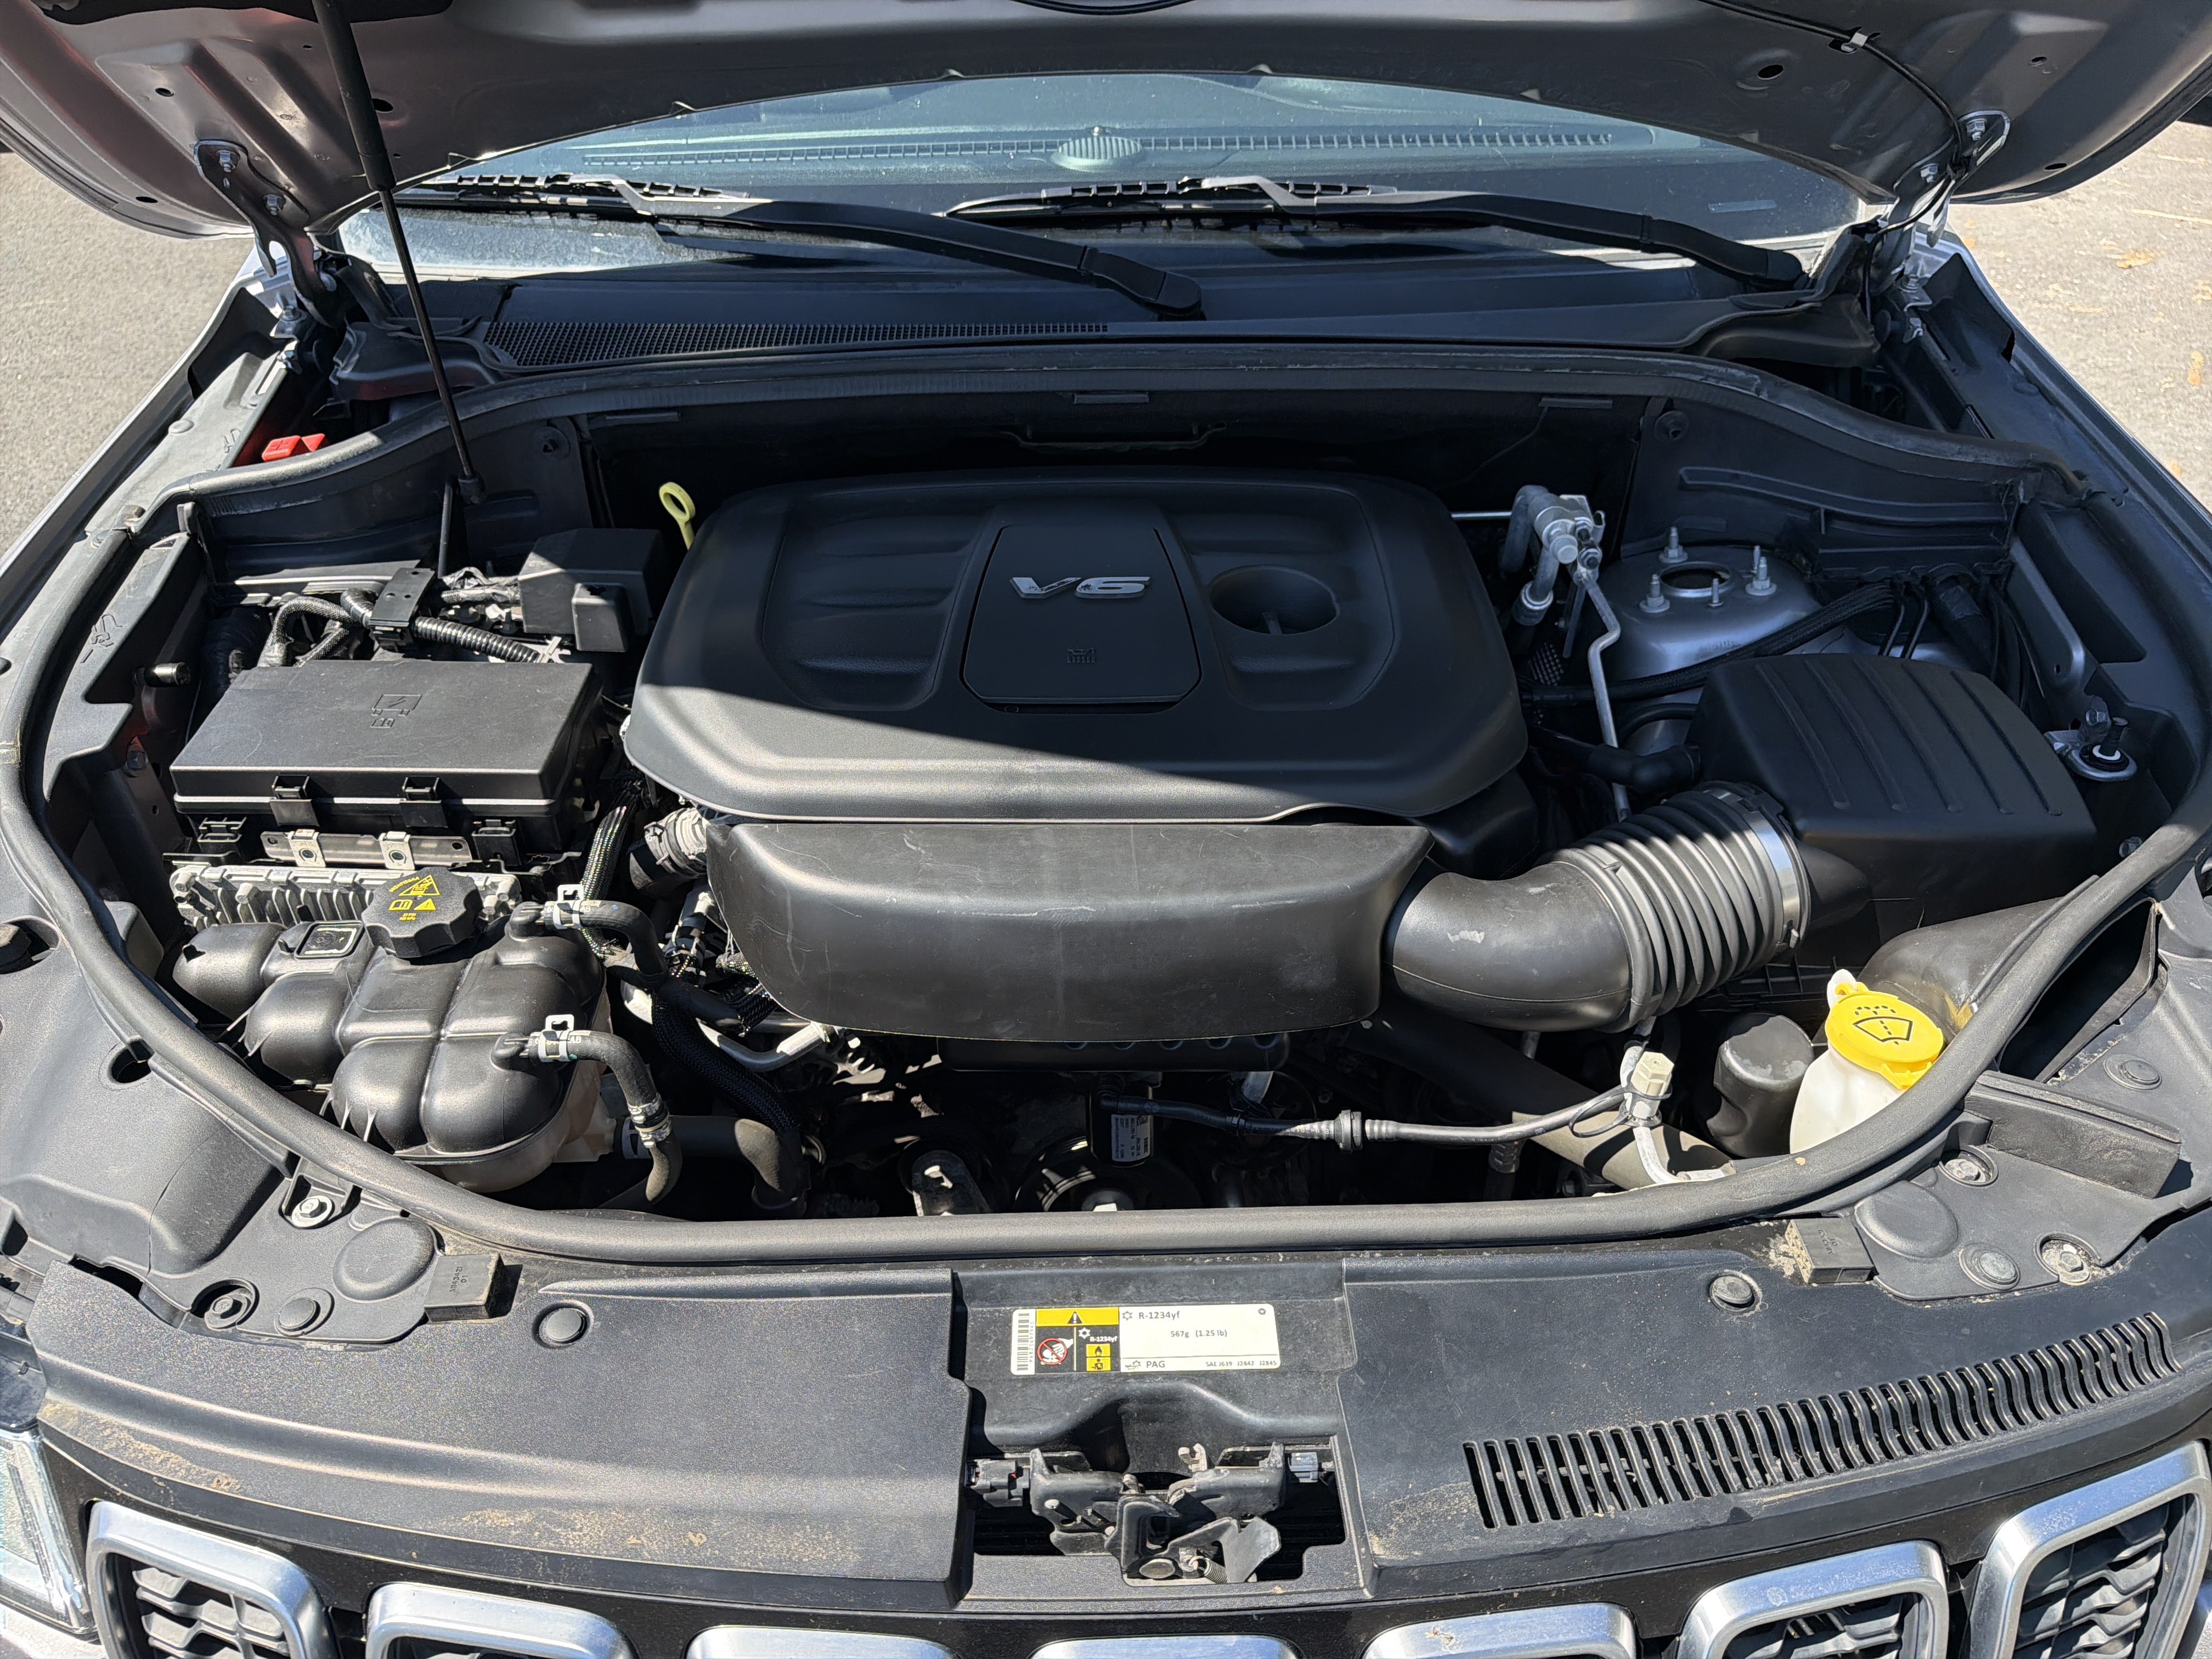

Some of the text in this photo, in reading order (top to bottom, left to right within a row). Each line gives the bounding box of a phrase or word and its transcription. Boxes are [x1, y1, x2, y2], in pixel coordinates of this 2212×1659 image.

[1010, 576, 1150, 599] V6
[1138, 1310, 1180, 1321] R-1234yf
[1170, 1328, 1228, 1339] 567g (1.25 lb)
[1146, 1360, 1166, 1369] PAG
